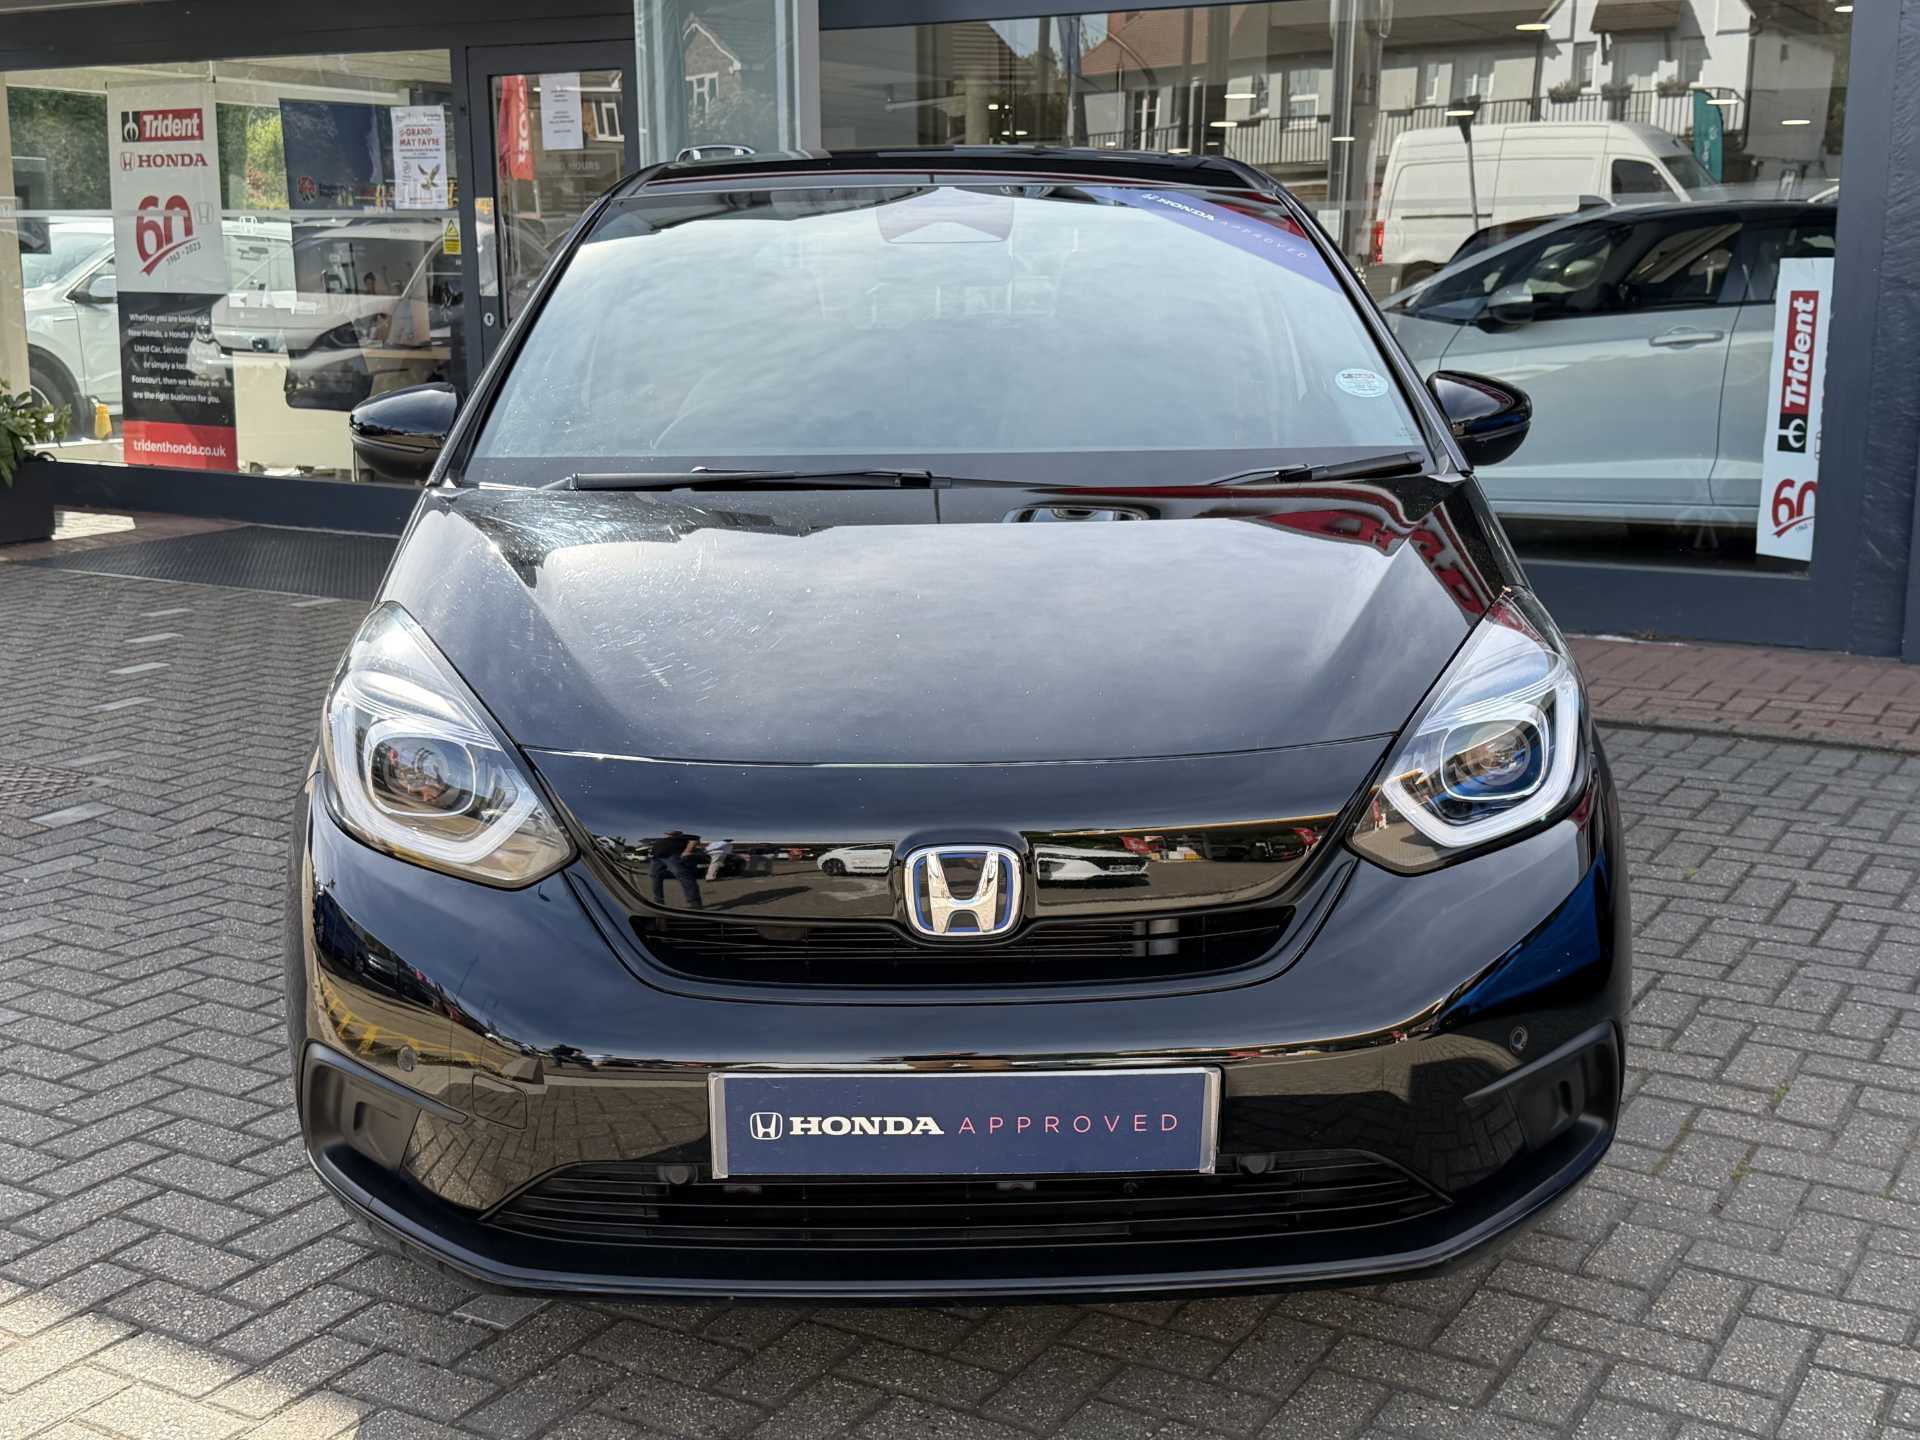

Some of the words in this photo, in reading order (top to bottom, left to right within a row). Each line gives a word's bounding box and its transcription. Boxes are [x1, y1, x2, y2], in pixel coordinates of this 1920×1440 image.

[142, 112, 200, 138] Trident
[137, 152, 209, 169] HONDA
[1156, 197, 1216, 222] HONDA
[135, 194, 194, 263] 60
[128, 313, 155, 322] Whether
[134, 345, 150, 353] Used
[1784, 295, 1816, 409] Trident
[133, 439, 226, 458] tridenthonda.co.uk
[789, 1116, 945, 1136] HONDA
[958, 1113, 1180, 1136] APPROVED
